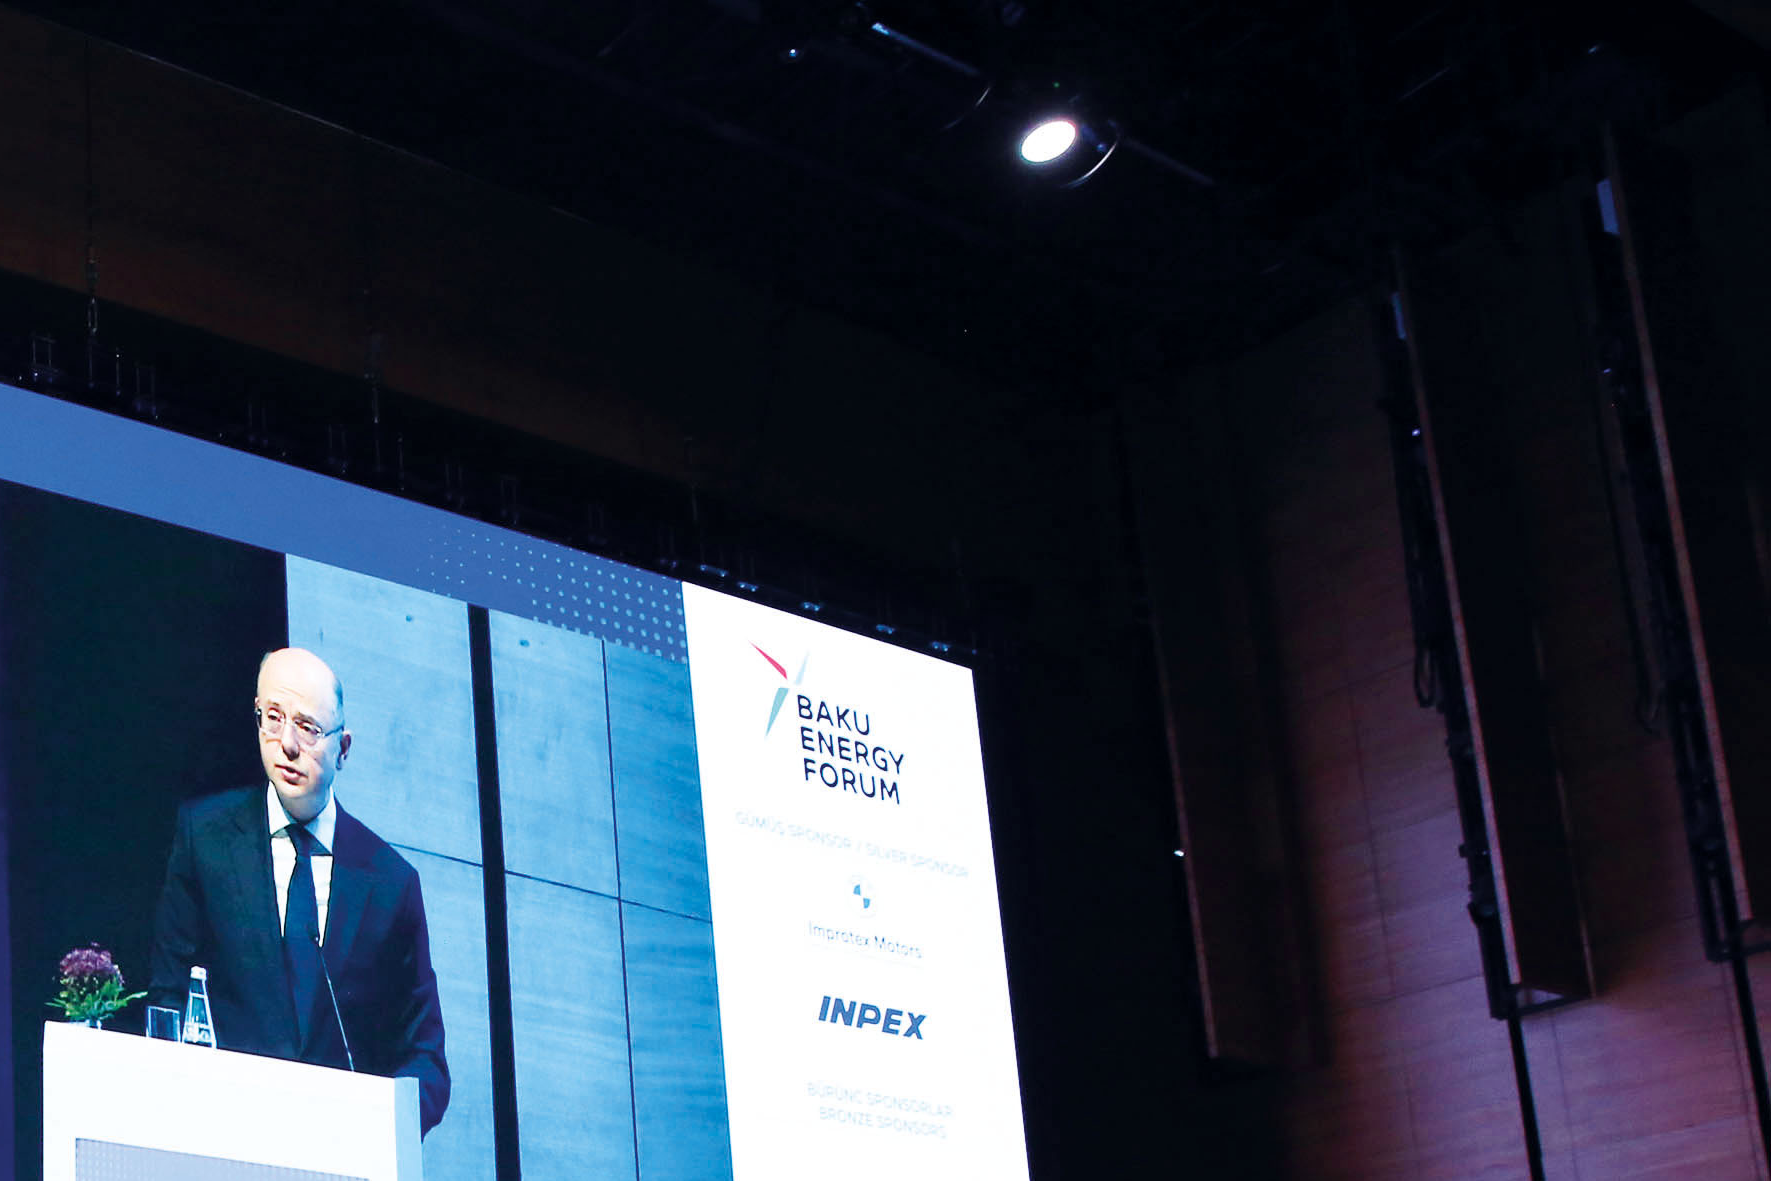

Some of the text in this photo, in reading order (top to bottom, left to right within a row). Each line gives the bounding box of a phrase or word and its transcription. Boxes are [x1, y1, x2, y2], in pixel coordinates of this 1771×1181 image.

[797, 694, 870, 736] BAKU
[800, 726, 904, 774] ENERGY
[804, 757, 899, 804] FORUM
[818, 996, 926, 1040] INPEX
